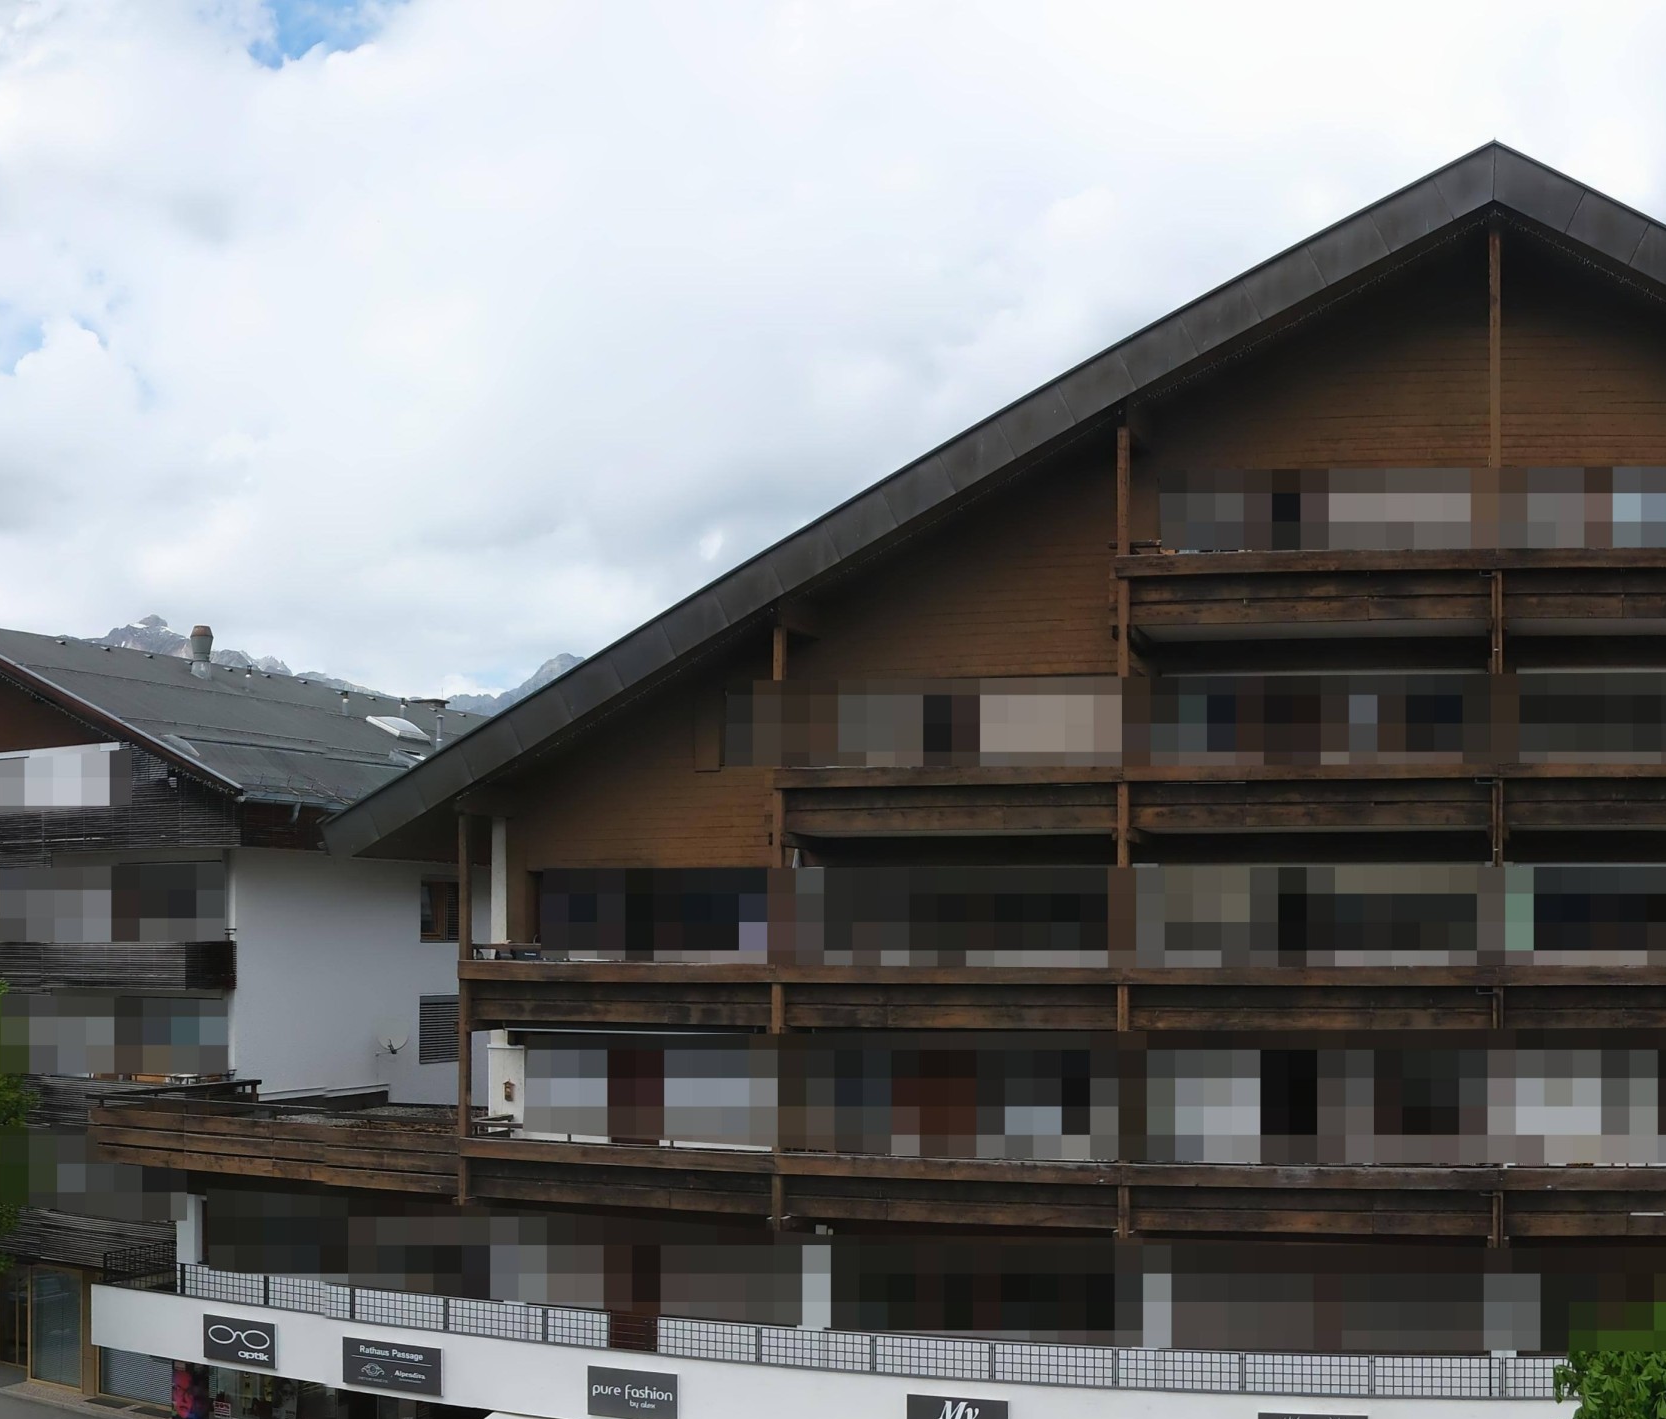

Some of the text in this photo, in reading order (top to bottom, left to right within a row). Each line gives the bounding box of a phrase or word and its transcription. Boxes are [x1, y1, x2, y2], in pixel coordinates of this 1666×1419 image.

[238, 1350, 269, 1361] optik
[359, 1345, 424, 1361] Rathaus Passage
[592, 1384, 673, 1401] pure fashion
[629, 1400, 639, 1409] by
